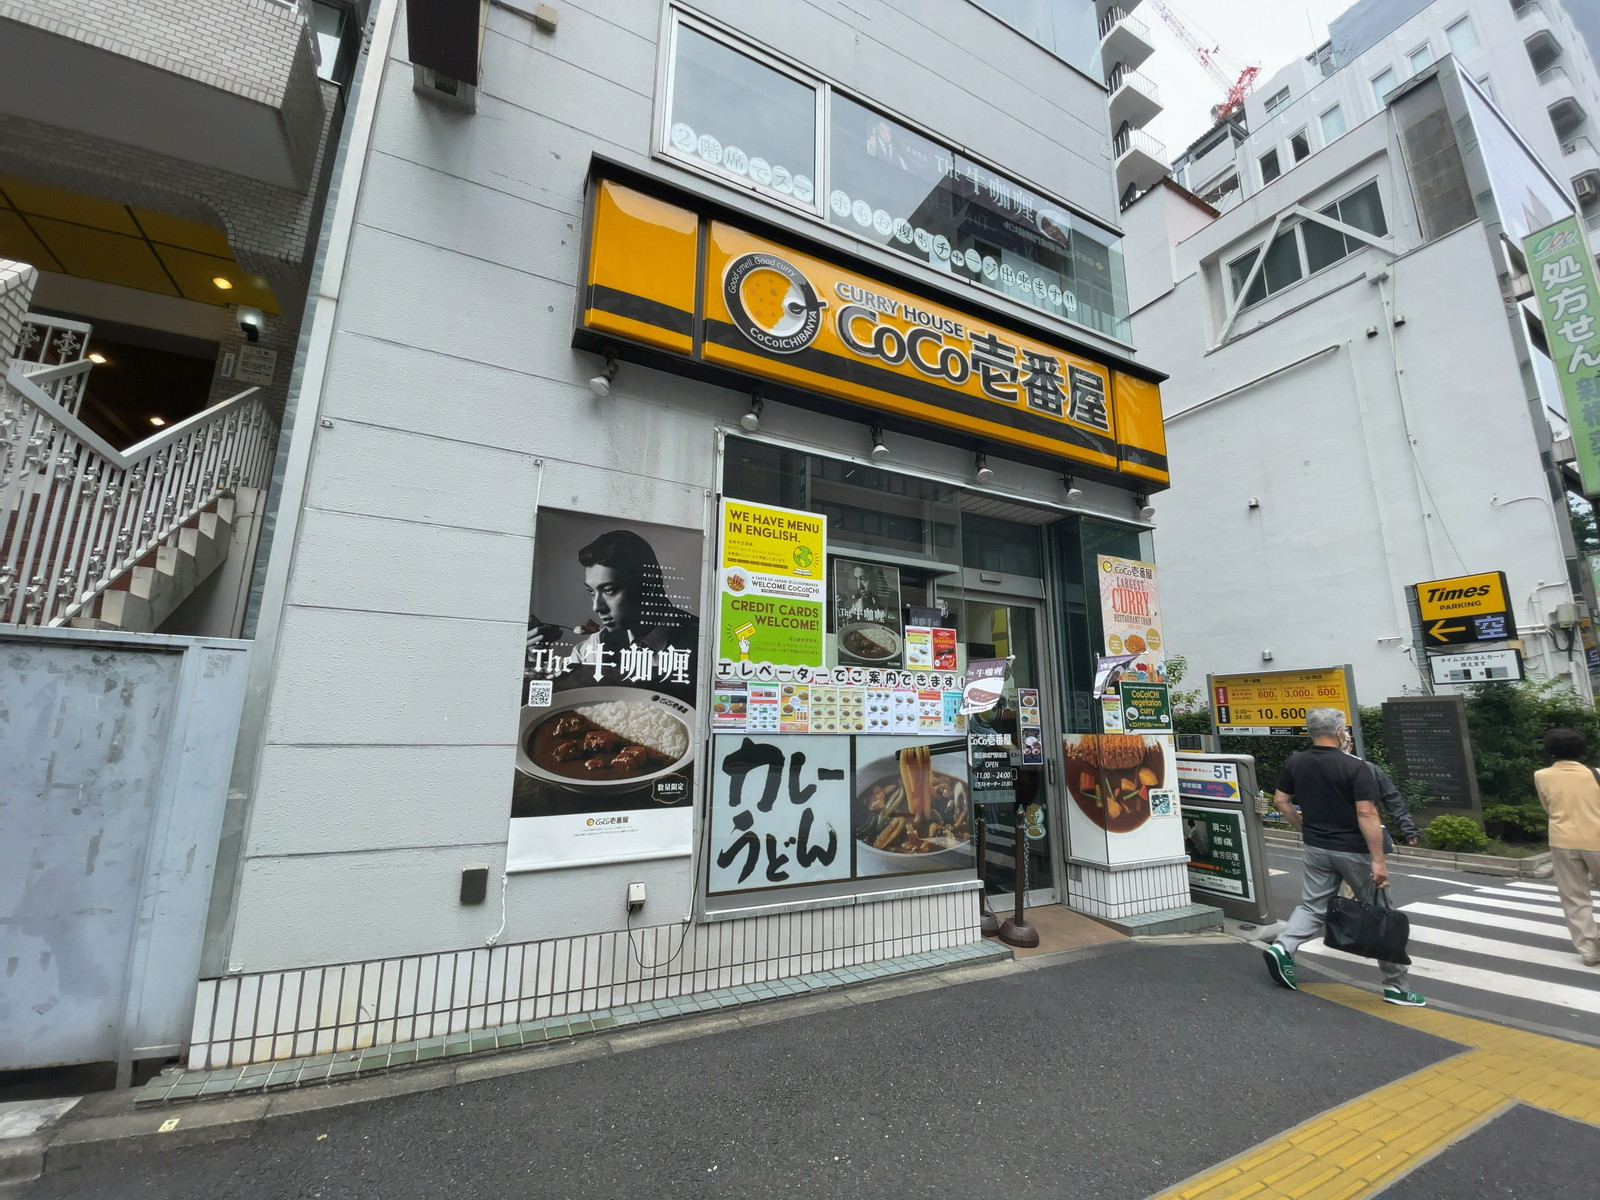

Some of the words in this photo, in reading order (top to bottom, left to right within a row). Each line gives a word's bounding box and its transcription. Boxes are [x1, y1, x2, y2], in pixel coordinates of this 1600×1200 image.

[676, 126, 811, 198] 2階席でスマ
[728, 271, 740, 294] Good
[754, 256, 776, 266] Good
[776, 262, 797, 277] curry
[836, 283, 900, 316] CURRY
[903, 306, 964, 339] HOUSE
[749, 309, 819, 349] CoCoICHIBANYA
[835, 304, 1110, 433] CoCo壱番屋
[729, 509, 750, 522] WE
[752, 513, 785, 528] HAVE
[787, 519, 820, 534] MENU
[729, 522, 742, 534] IN
[745, 525, 801, 543] ENGLISH.
[1114, 565, 1153, 580] CoCo壱番屋
[751, 580, 787, 590] WELCOME
[787, 584, 820, 594] CoCoICHI
[1116, 577, 1145, 591] LARGEST
[1427, 584, 1491, 603] Times
[731, 599, 775, 614] CREDIT
[778, 604, 819, 618] CARDS
[1112, 587, 1150, 617] CURRY
[1439, 600, 1482, 611] PARKING
[754, 614, 819, 631] WELCOME!
[1114, 613, 1141, 625] RESTAURANT
[1140, 616, 1152, 626] CHAIN
[531, 648, 574, 673] The
[1440, 653, 1506, 664] タイムズの法人カード
[718, 663, 964, 688] エレベーターでご案内できます!
[1131, 690, 1159, 698] CoCoICHI
[1257, 690, 1275, 699] 600
[1284, 689, 1310, 699] 3,000
[1317, 687, 1336, 697] 600
[1131, 699, 1162, 707] vegetarian
[1140, 707, 1155, 715] curry
[1256, 708, 1274, 720] 10
[1280, 707, 1307, 720] 600
[722, 737, 845, 812] カレー
[996, 771, 1011, 779] 24:00
[1213, 764, 1232, 780] 5F
[657, 782, 684, 792] 数量限定
[1211, 822, 1232, 834] 肩こり
[717, 807, 838, 884] うどん
[1213, 836, 1233, 848] 腰痛
[1212, 850, 1240, 862] 疲労回復
